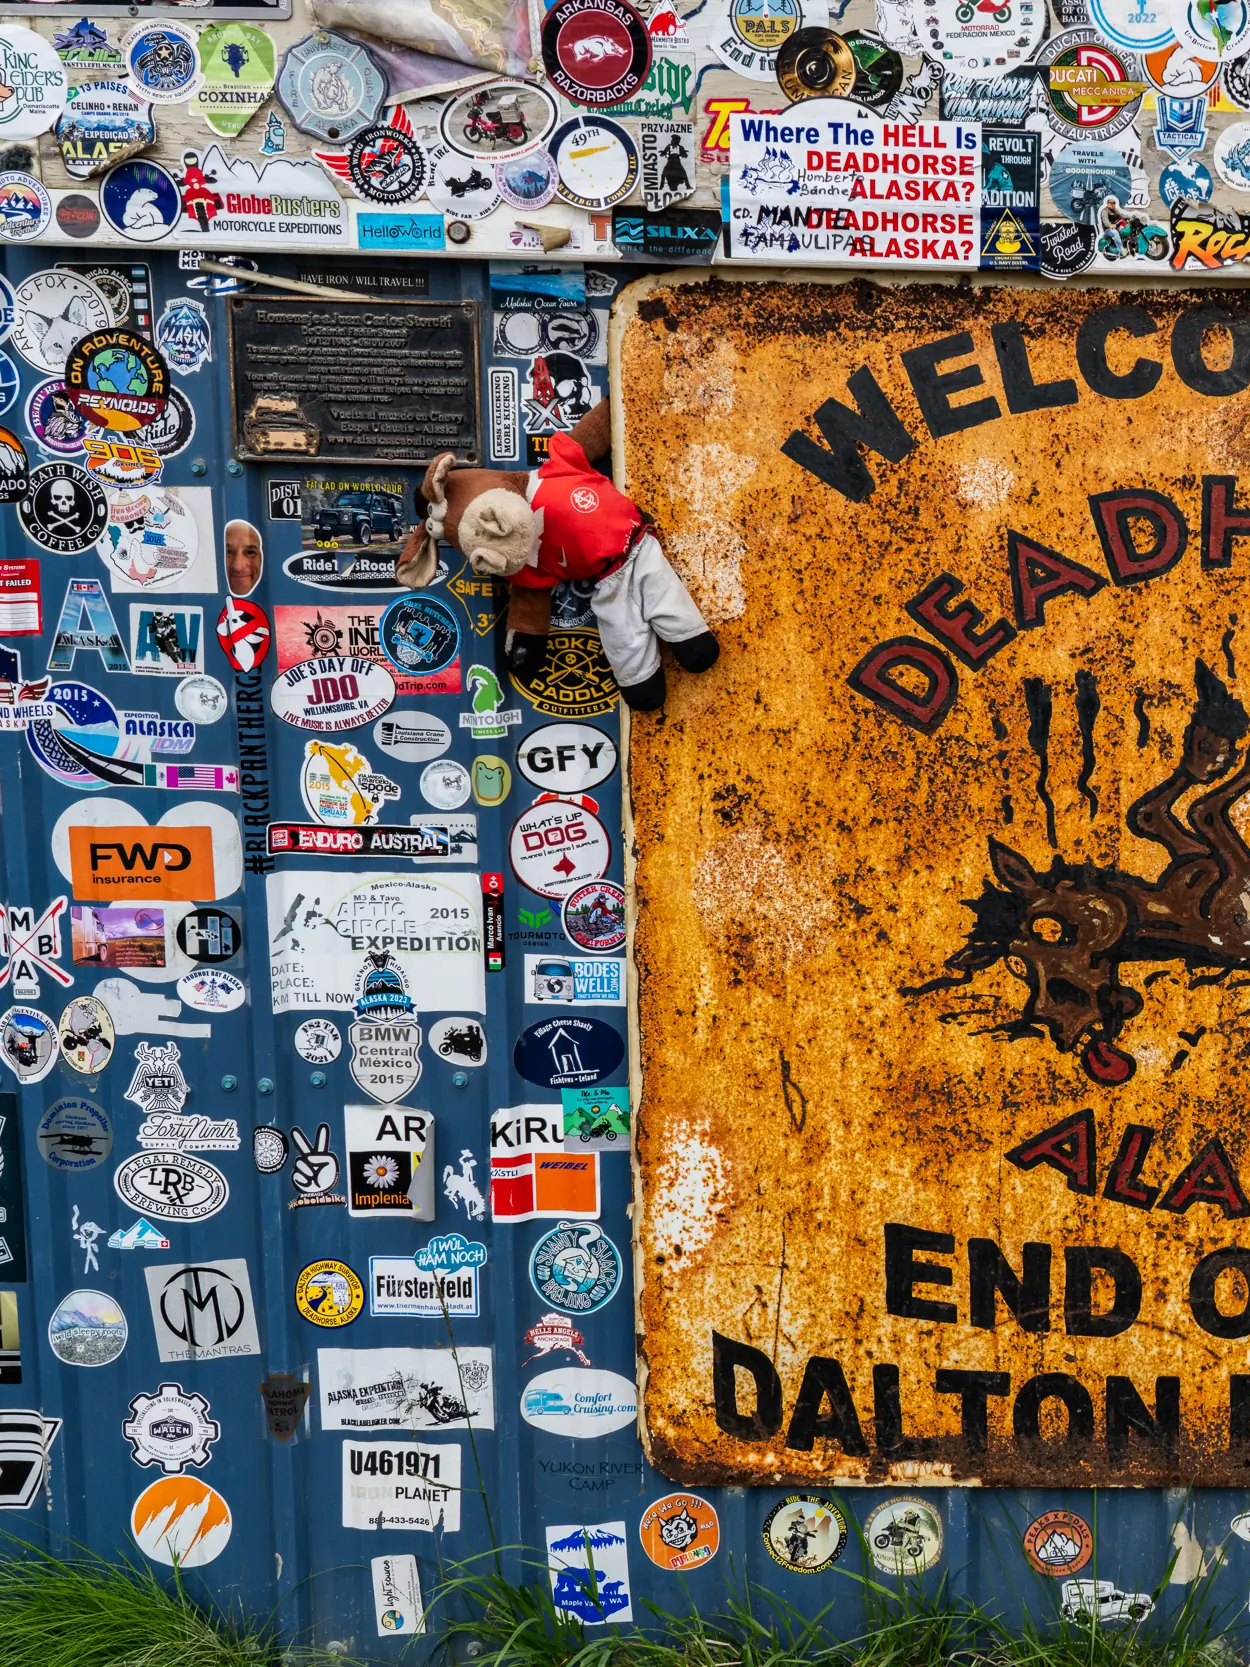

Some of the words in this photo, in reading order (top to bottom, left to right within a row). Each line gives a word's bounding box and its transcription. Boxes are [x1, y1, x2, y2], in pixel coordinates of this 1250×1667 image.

[553, 70, 639, 104] RAZORBACKS
[71, 102, 105, 112] CELINHO
[112, 102, 139, 112] RENAN
[641, 123, 692, 133] PRZYJAZNE
[741, 120, 820, 145] Where
[828, 121, 874, 145] The
[883, 124, 945, 148] HELL
[956, 128, 977, 150] Is
[643, 134, 657, 191] MIASTO
[807, 150, 975, 175] DEADHORSE
[852, 180, 975, 201] ALASKA?
[227, 194, 340, 217] GlobeBusters
[213, 221, 275, 234] MOTORCYCLE
[279, 222, 342, 235] EXPEDITIONS
[807, 208, 973, 234] DEADHORSE
[849, 236, 973, 260] ALASKA?
[300, 274, 324, 284] HAVE
[326, 275, 349, 285] IRON
[356, 276, 377, 286] WILL
[380, 277, 414, 287] TRAVEL
[534, 297, 557, 309] Ocean
[558, 297, 577, 309] Tours
[83, 334, 164, 394] ADVENTURE
[77, 393, 156, 416] REYNOLDS
[503, 376, 511, 423] KICKING
[503, 426, 511, 453] MORE
[306, 480, 318, 489] FAT
[320, 481, 336, 491] LAD
[338, 482, 350, 491] ON
[352, 482, 380, 492] WORLD
[383, 483, 402, 493] TOUR
[54, 689, 88, 700] 2015
[307, 674, 359, 704] JDO
[126, 720, 194, 737] ALASKA
[528, 743, 606, 771] GFY
[90, 843, 191, 871] FWD
[92, 874, 161, 884] insurance
[430, 908, 469, 919] 2015
[351, 936, 481, 952] EXPEDITION
[575, 962, 618, 978] BODES
[575, 978, 609, 992] WELL
[359, 1028, 411, 1041] BMW
[359, 1046, 412, 1057] Central
[359, 1057, 412, 1068] México
[370, 1074, 404, 1084] 2015
[540, 1161, 588, 1171] WEIBEL
[355, 1192, 409, 1207] Implenia
[884, 1223, 1142, 1337] END
[552, 1328, 579, 1337] ANGELS
[574, 1392, 612, 1403] Comfort
[713, 1330, 1181, 1466] DALTON
[573, 1403, 637, 1415] Cruising.com
[350, 1450, 440, 1477] U461971
[539, 1460, 596, 1475] YUKON
[599, 1462, 644, 1475] RIVER
[570, 1477, 614, 1492] CAMP
[396, 1486, 450, 1501] PLANET
